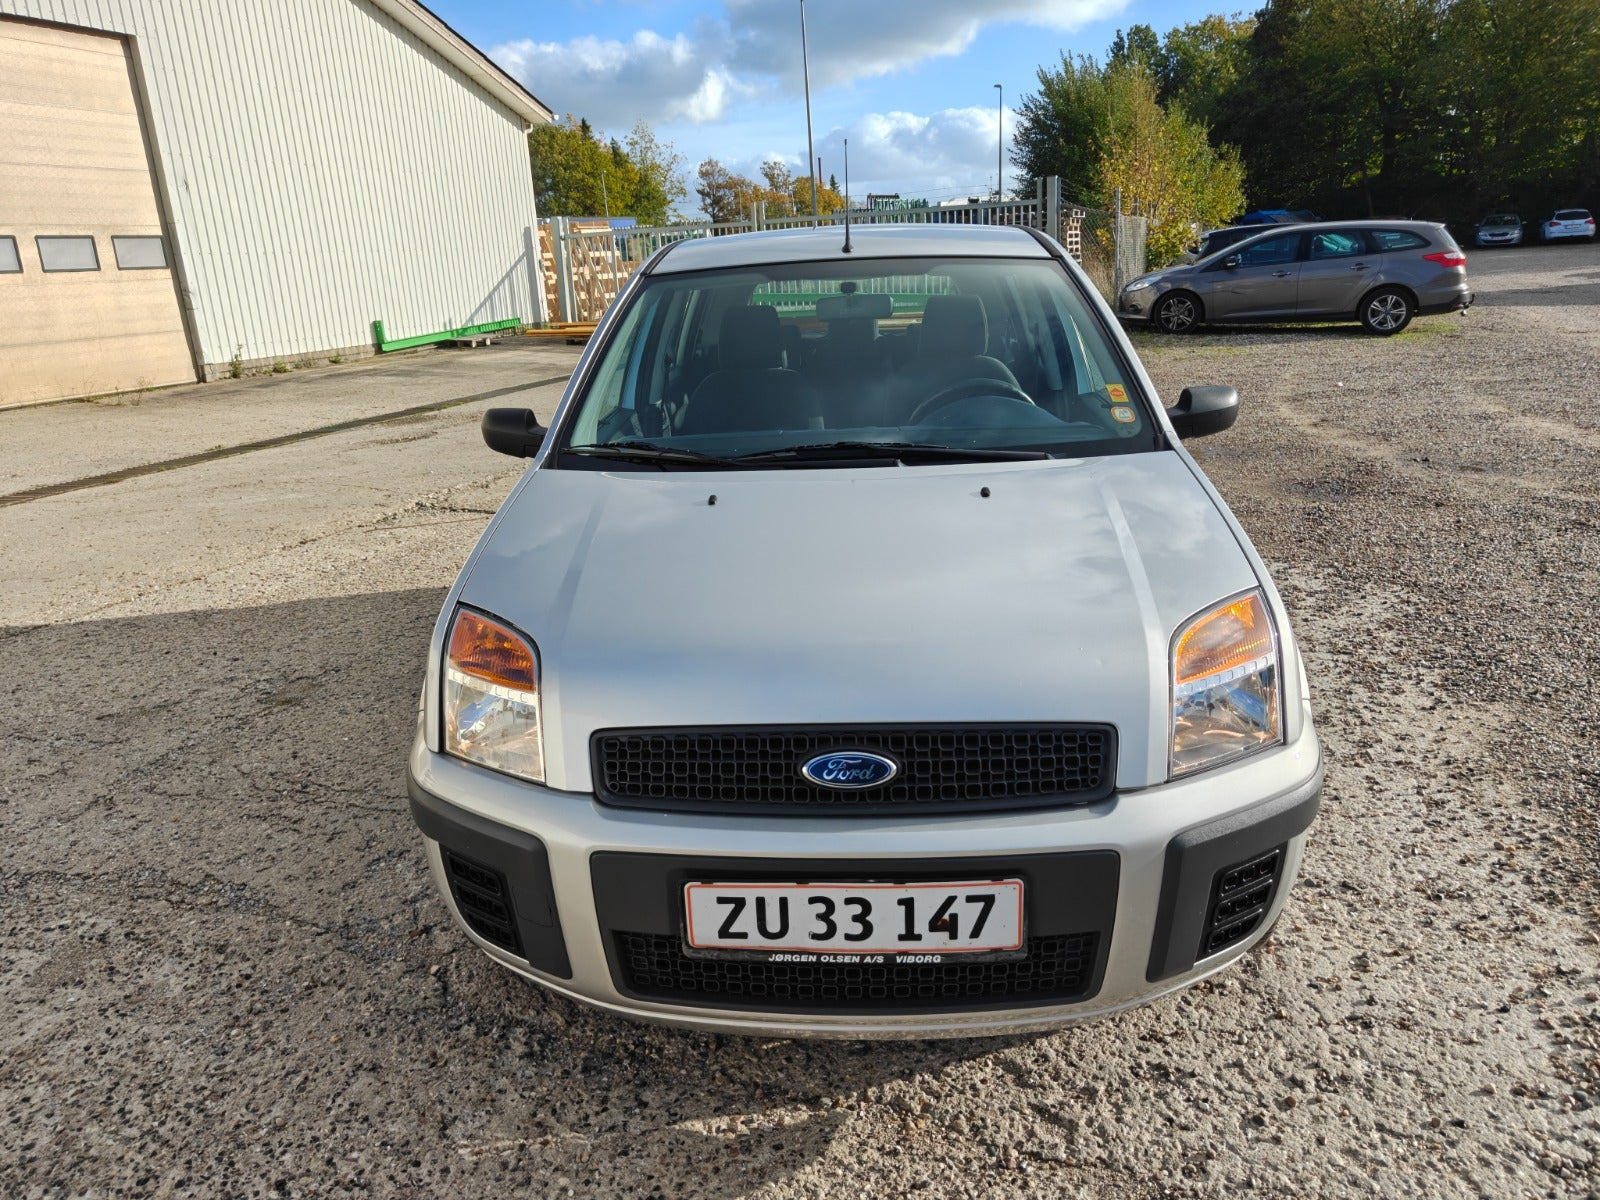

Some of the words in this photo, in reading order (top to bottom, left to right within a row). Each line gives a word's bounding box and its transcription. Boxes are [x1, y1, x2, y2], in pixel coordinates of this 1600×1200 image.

[822, 758, 875, 780] Ford
[715, 896, 790, 940] ZU
[807, 895, 874, 942] 33
[896, 893, 996, 942] 147
[768, 953, 817, 963] JØRGEN
[820, 953, 861, 963] OLSEN
[863, 953, 885, 963] A/S
[896, 953, 942, 964] VIBORG
